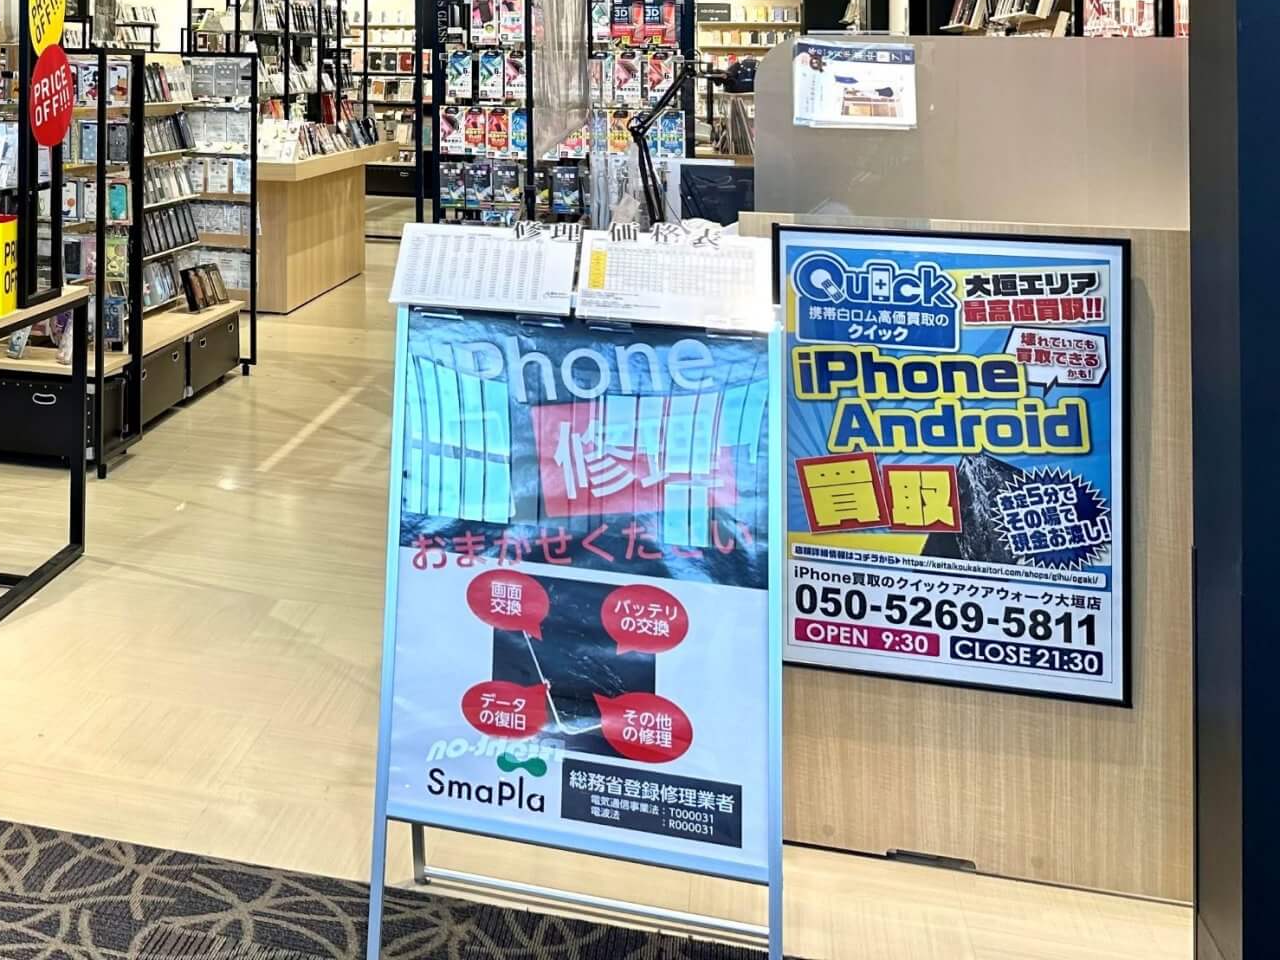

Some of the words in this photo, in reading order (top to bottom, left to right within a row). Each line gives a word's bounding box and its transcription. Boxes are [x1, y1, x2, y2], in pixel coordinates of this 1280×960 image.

[34, 64, 69, 106] PRICE
[35, 87, 71, 127] OFF!!!
[795, 254, 956, 308] Quick
[963, 271, 1099, 298] 大垣エリア
[808, 305, 950, 327] 携帯白ロム高価買取の
[848, 324, 909, 342] クイック
[1020, 331, 1096, 350] 壊れていても
[1016, 347, 1100, 368] 買取できる
[795, 347, 1023, 397] iPhone
[832, 400, 1086, 450] Android
[799, 455, 958, 530] 買取
[1005, 504, 1078, 532] その場で
[490, 581, 523, 600] 画面
[490, 598, 523, 617] 交換
[614, 599, 679, 621] バッテリ
[794, 583, 1097, 646] 050-5269-5811
[620, 616, 671, 638] の交換
[806, 623, 869, 647] OPEN
[881, 630, 930, 654] 9:30
[955, 640, 1032, 666] CLOSE
[1035, 648, 1100, 673] 21:30
[480, 692, 527, 713] データ
[479, 710, 527, 731] の復旧
[622, 709, 673, 731] その他
[622, 726, 673, 748] の修理
[427, 767, 546, 813] SmaPla
[569, 770, 735, 814] 総務省登録修理業者
[590, 806, 621, 821] 電波法
